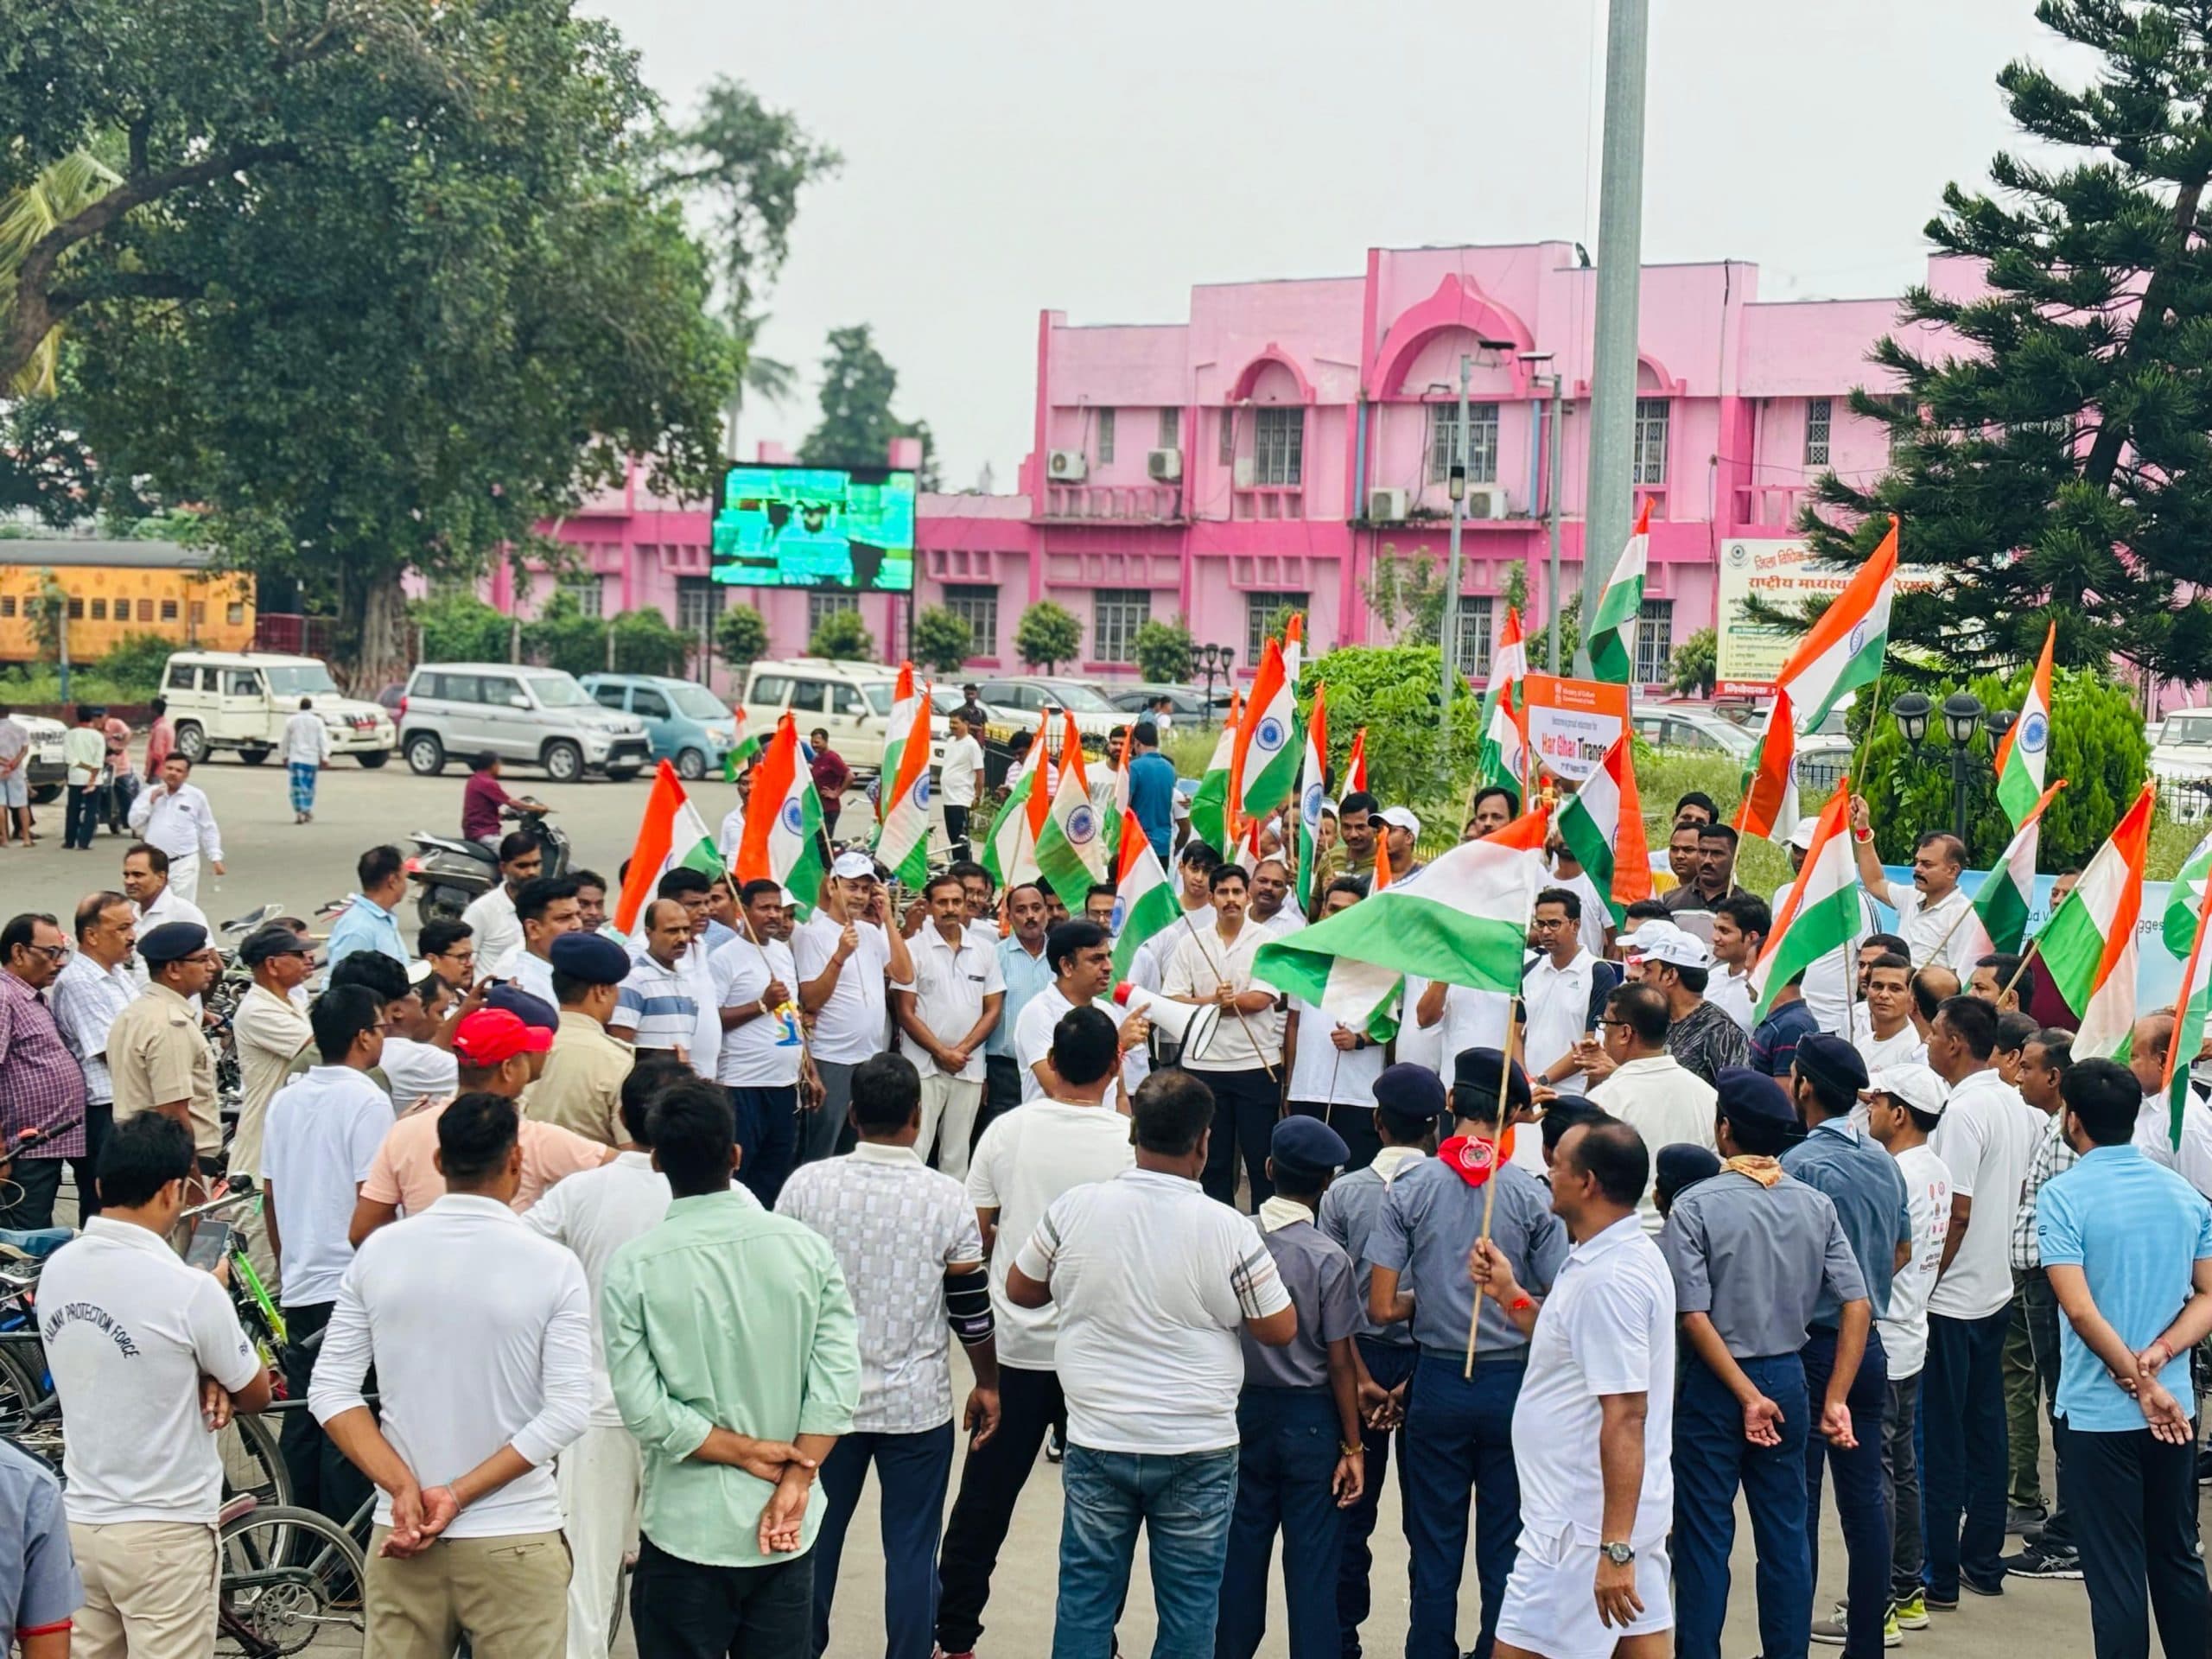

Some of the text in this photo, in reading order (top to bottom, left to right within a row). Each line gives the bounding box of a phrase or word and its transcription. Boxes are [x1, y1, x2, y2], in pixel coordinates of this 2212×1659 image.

[1749, 575, 1794, 590] राष्ट्रीय
[1542, 733, 1556, 754] Har
[65, 1302, 114, 1333] PROTECTION
[111, 1325, 141, 1359] FORCE
